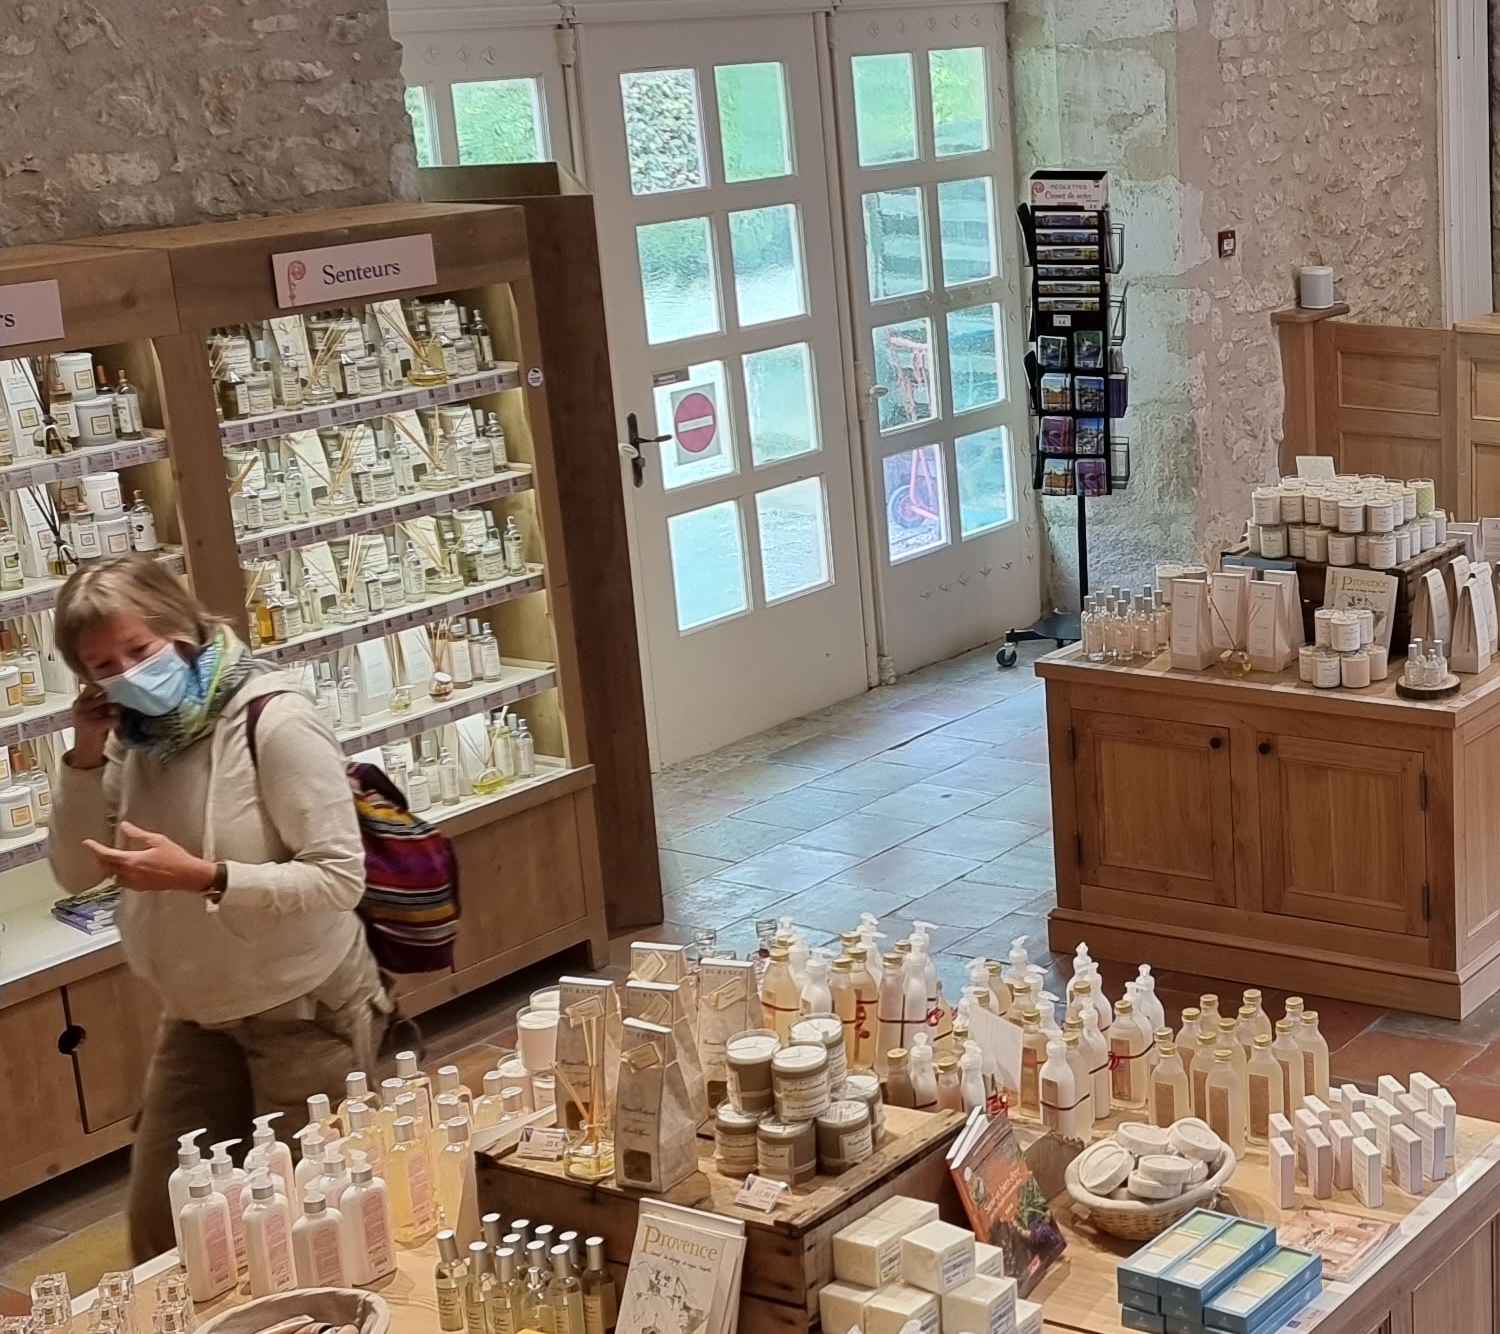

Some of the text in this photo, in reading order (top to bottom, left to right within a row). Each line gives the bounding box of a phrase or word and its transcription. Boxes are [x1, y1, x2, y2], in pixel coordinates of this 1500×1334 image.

[322, 262, 401, 285] Senteurs
[1341, 575, 1390, 591] Provence
[704, 968, 745, 977] DURANCE
[640, 1223, 719, 1262] Provence
